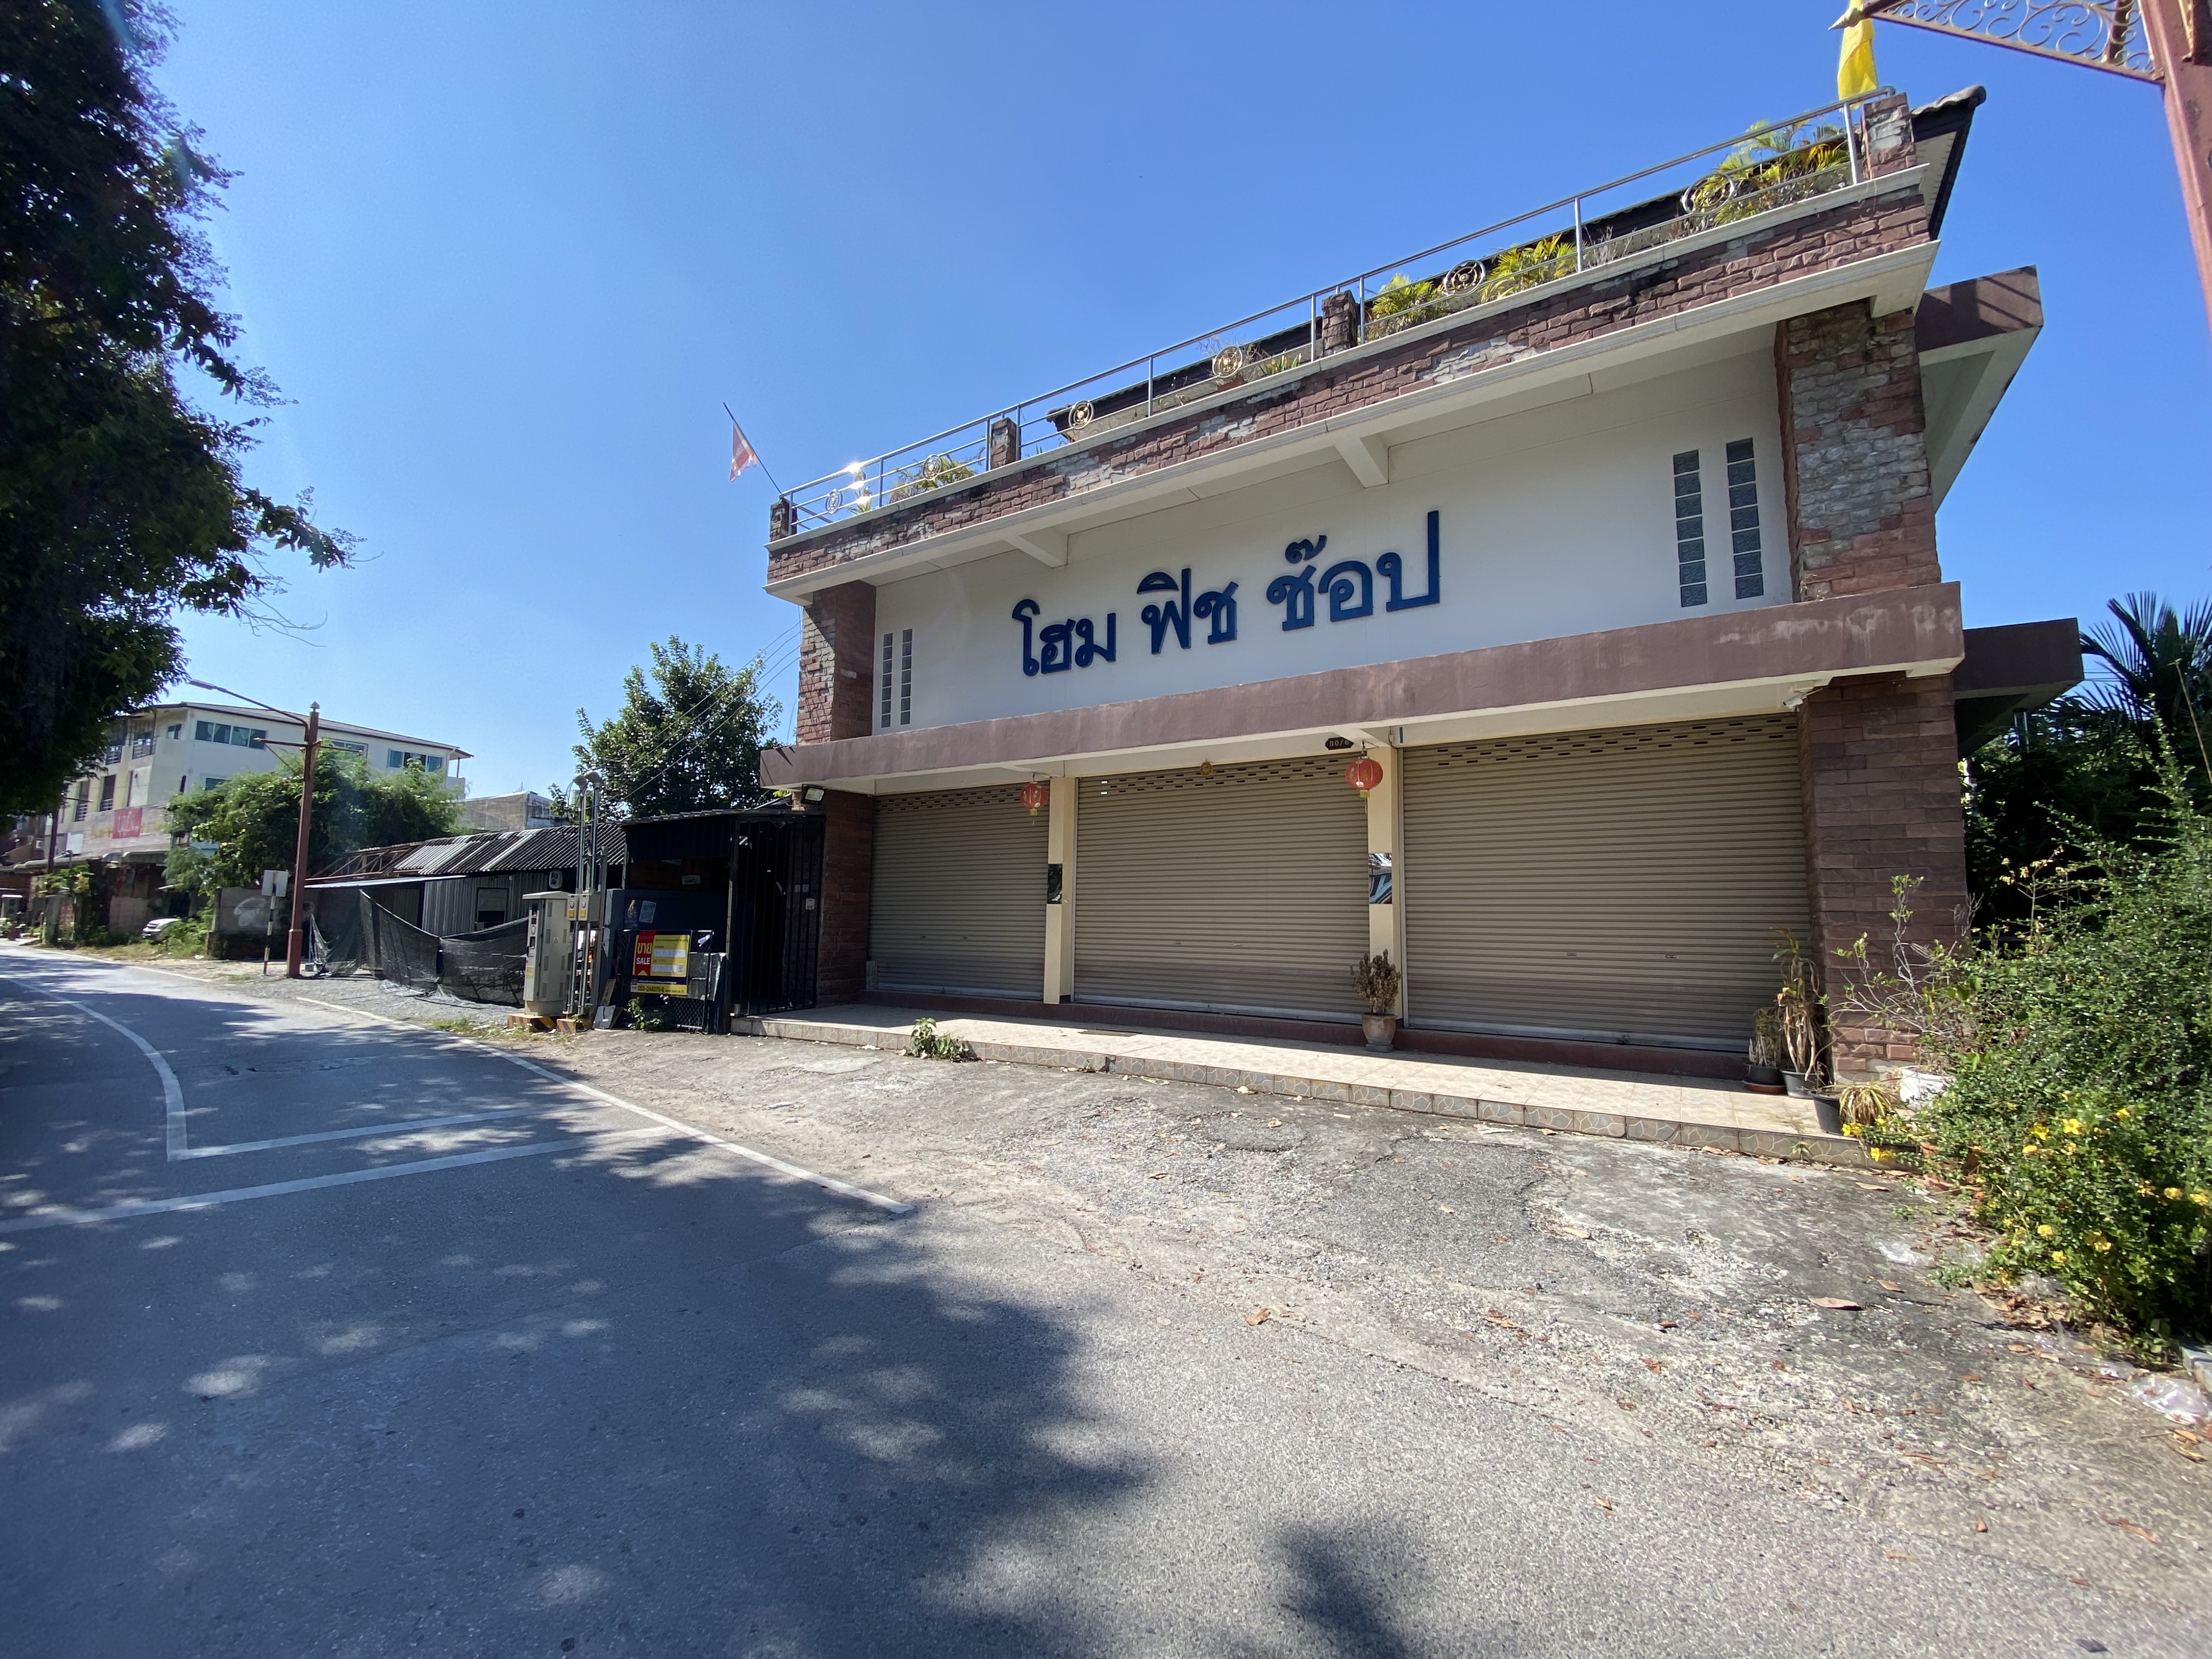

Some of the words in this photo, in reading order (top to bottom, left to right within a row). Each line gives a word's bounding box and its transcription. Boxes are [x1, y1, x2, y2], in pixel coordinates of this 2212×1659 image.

[1012, 598, 1116, 677] โฮม
[1136, 567, 1239, 655] ฟิช
[1266, 509, 1441, 632] ช๊อป
[637, 943, 652, 954] ขาย
